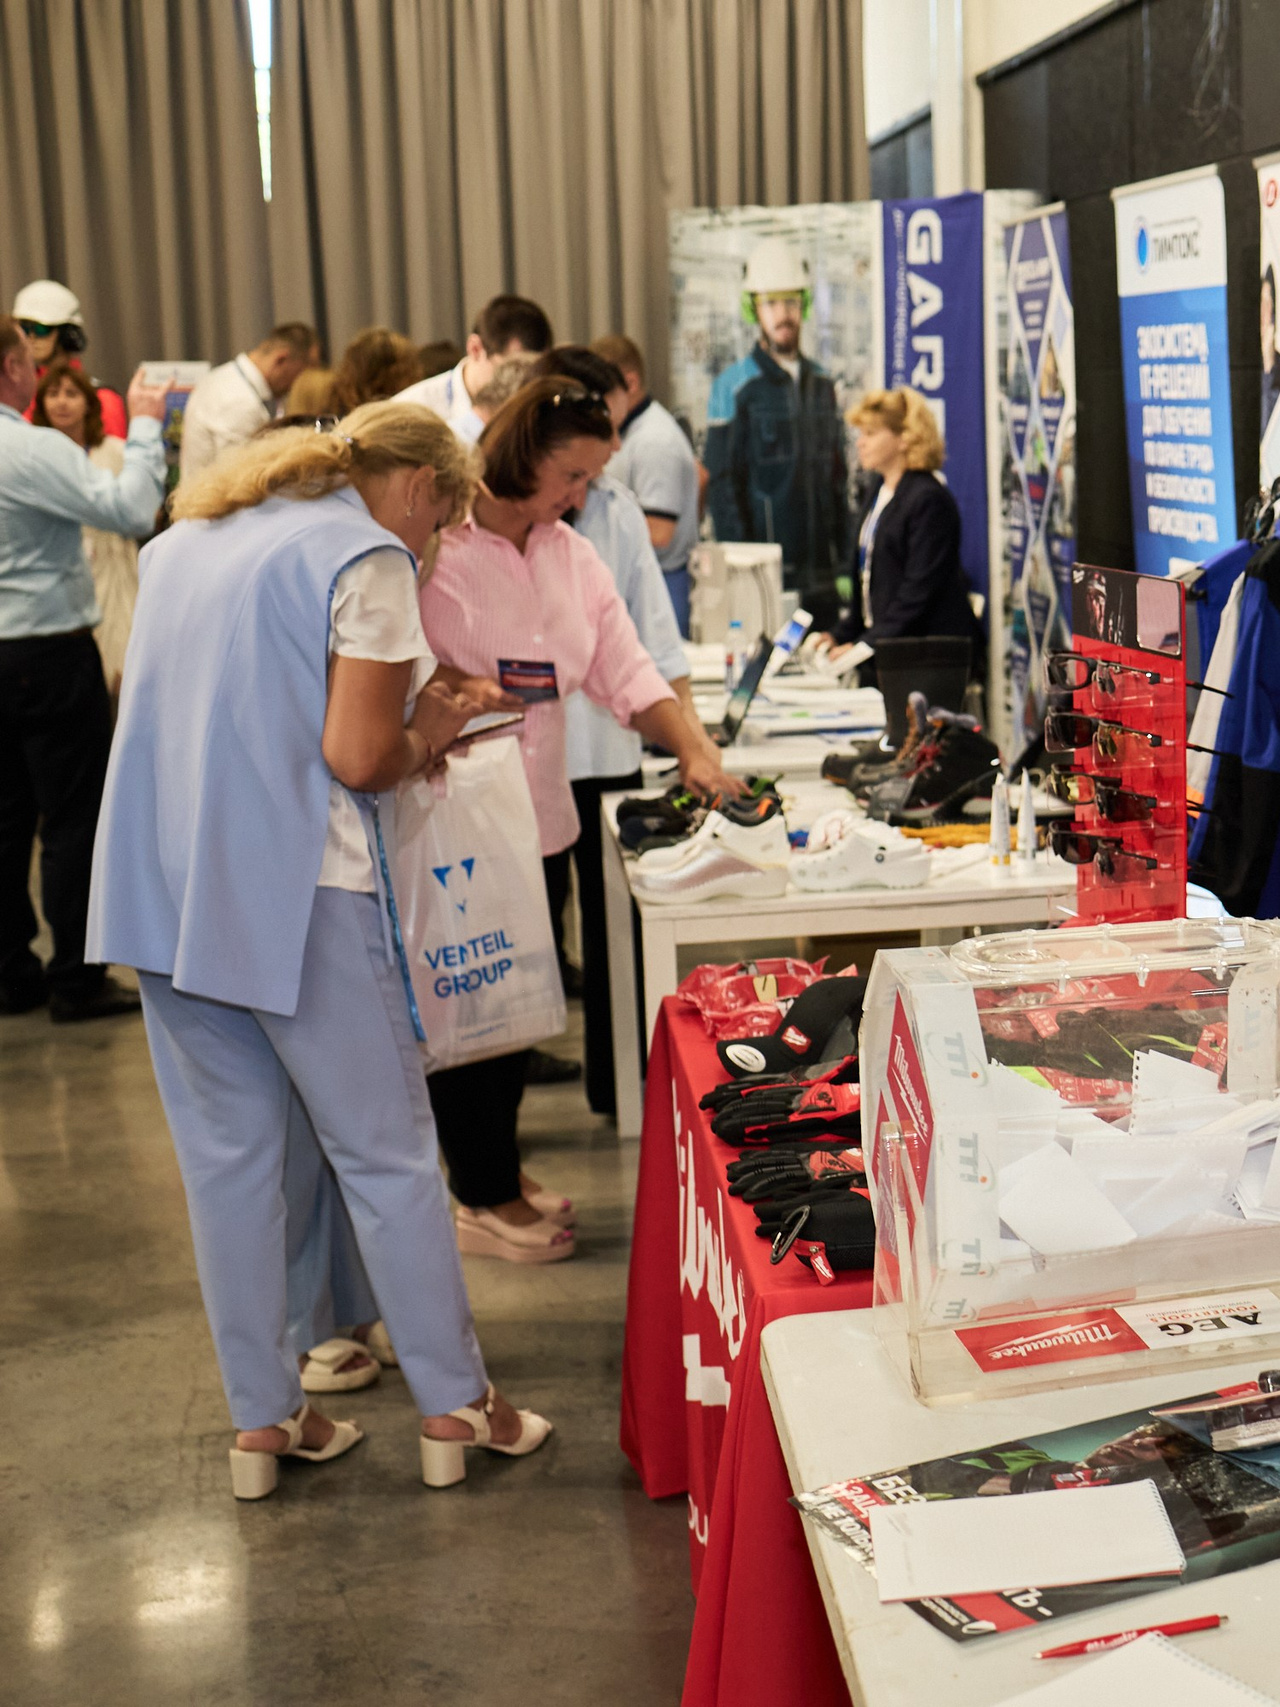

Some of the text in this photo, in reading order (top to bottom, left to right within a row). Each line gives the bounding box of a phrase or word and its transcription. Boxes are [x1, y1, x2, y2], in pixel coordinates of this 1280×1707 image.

[906, 208, 945, 438] GAR
[433, 958, 513, 998] GROUP
[1149, 1305, 1258, 1323] POWERTOOLS
[1157, 1311, 1263, 1337] AEG
[987, 1322, 1122, 1360] Milwaukee
